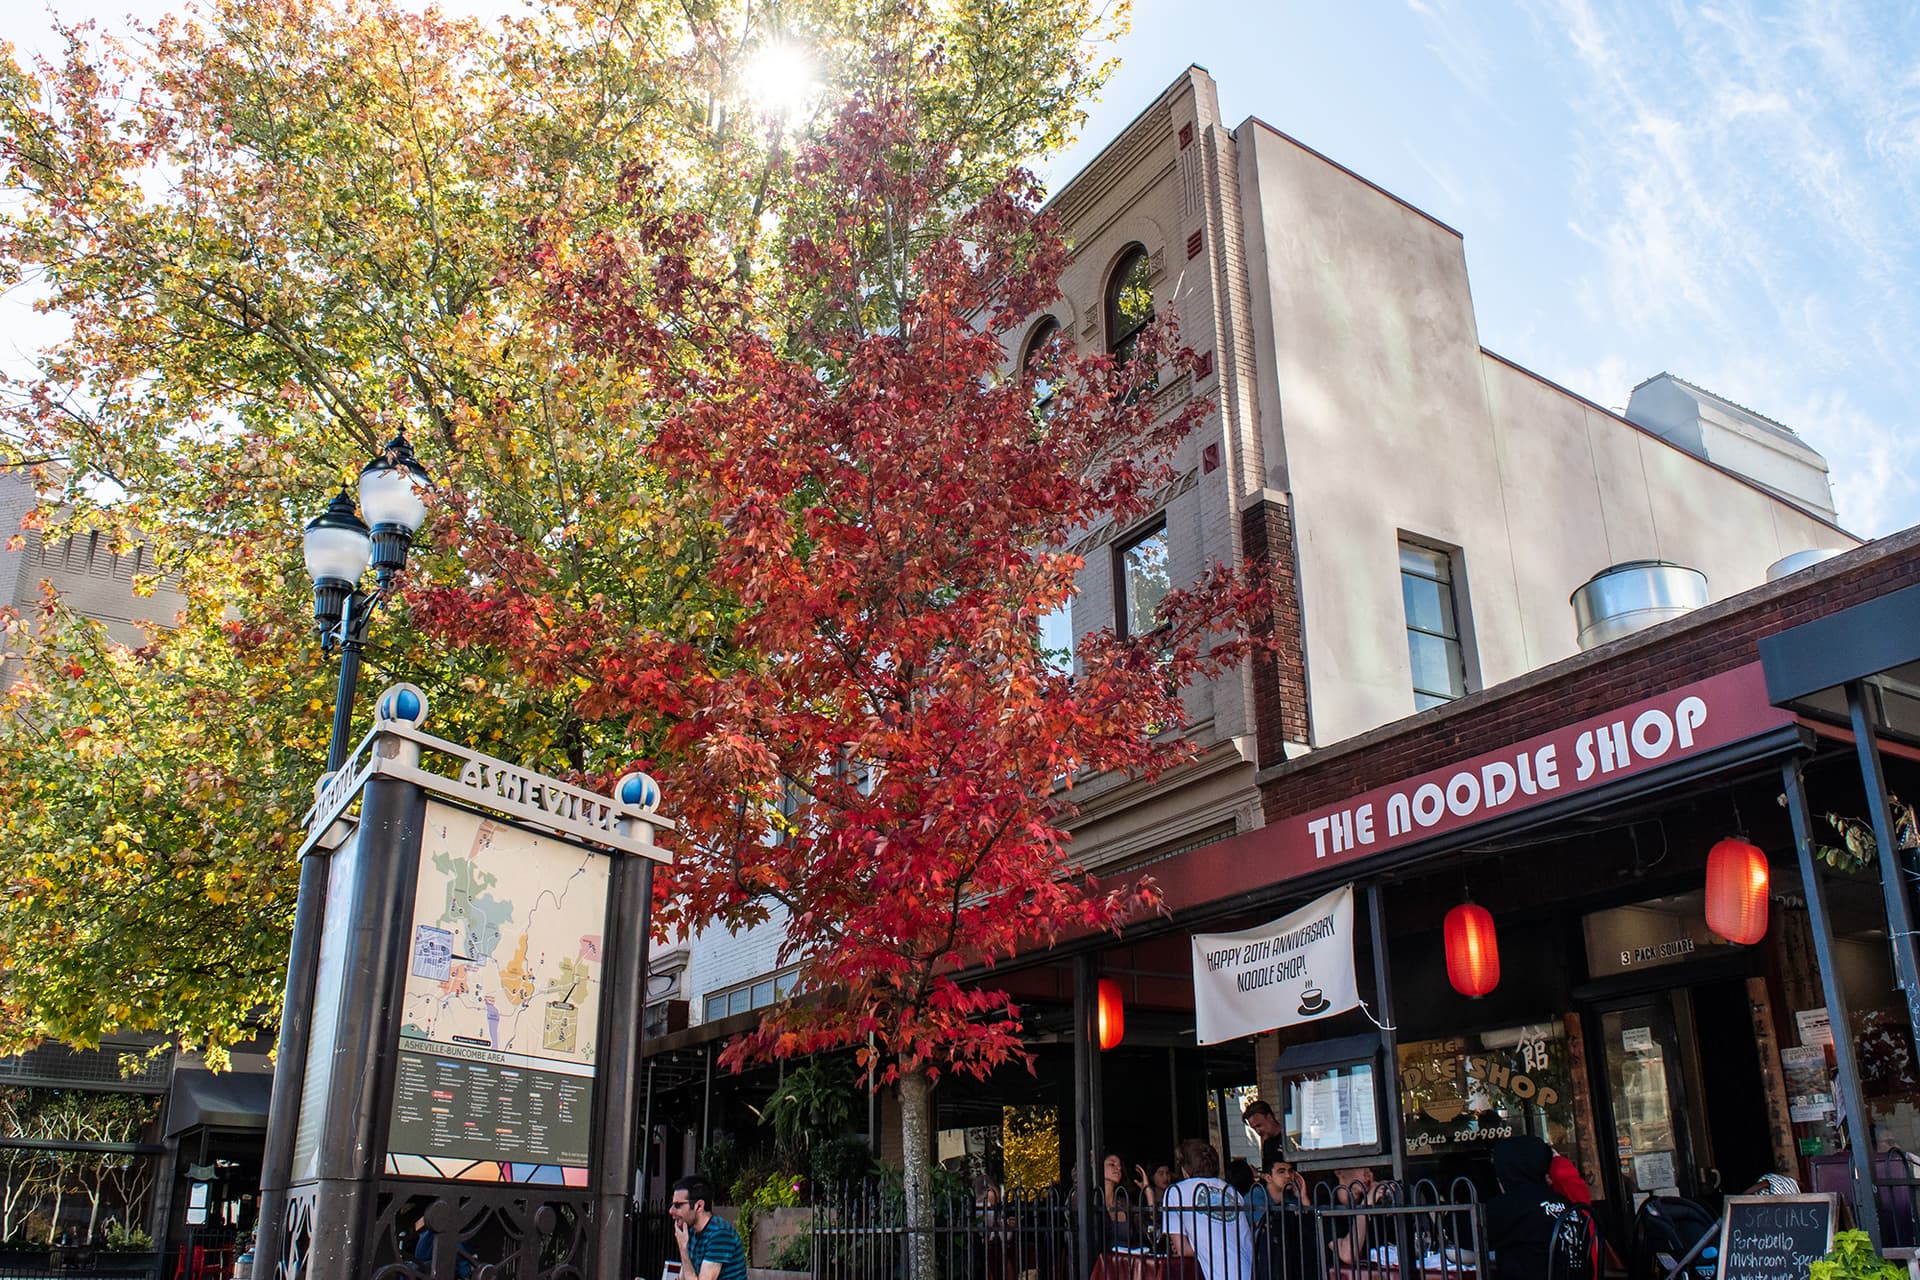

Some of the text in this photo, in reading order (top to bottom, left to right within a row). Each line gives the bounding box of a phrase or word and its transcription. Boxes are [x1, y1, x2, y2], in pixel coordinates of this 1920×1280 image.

[460, 758, 622, 832] ASHEVILLE
[1308, 695, 1707, 859] THE NOODLE SHOP
[1206, 914, 1336, 972] HAPPY 20TH ANNIVERSARY
[1622, 939, 1694, 964] 3 PACK SQUARE
[1237, 954, 1308, 993] NOODLE SHOP!
[404, 1040, 487, 1061] ASHEVILLE-BUNCOMBE
[487, 1053, 506, 1063] AREA
[1424, 1040, 1456, 1056] THE
[1516, 1025, 1550, 1073] 館
[1402, 1057, 1558, 1108] DLE SHOP
[1454, 1126, 1513, 1142] 260-9898
